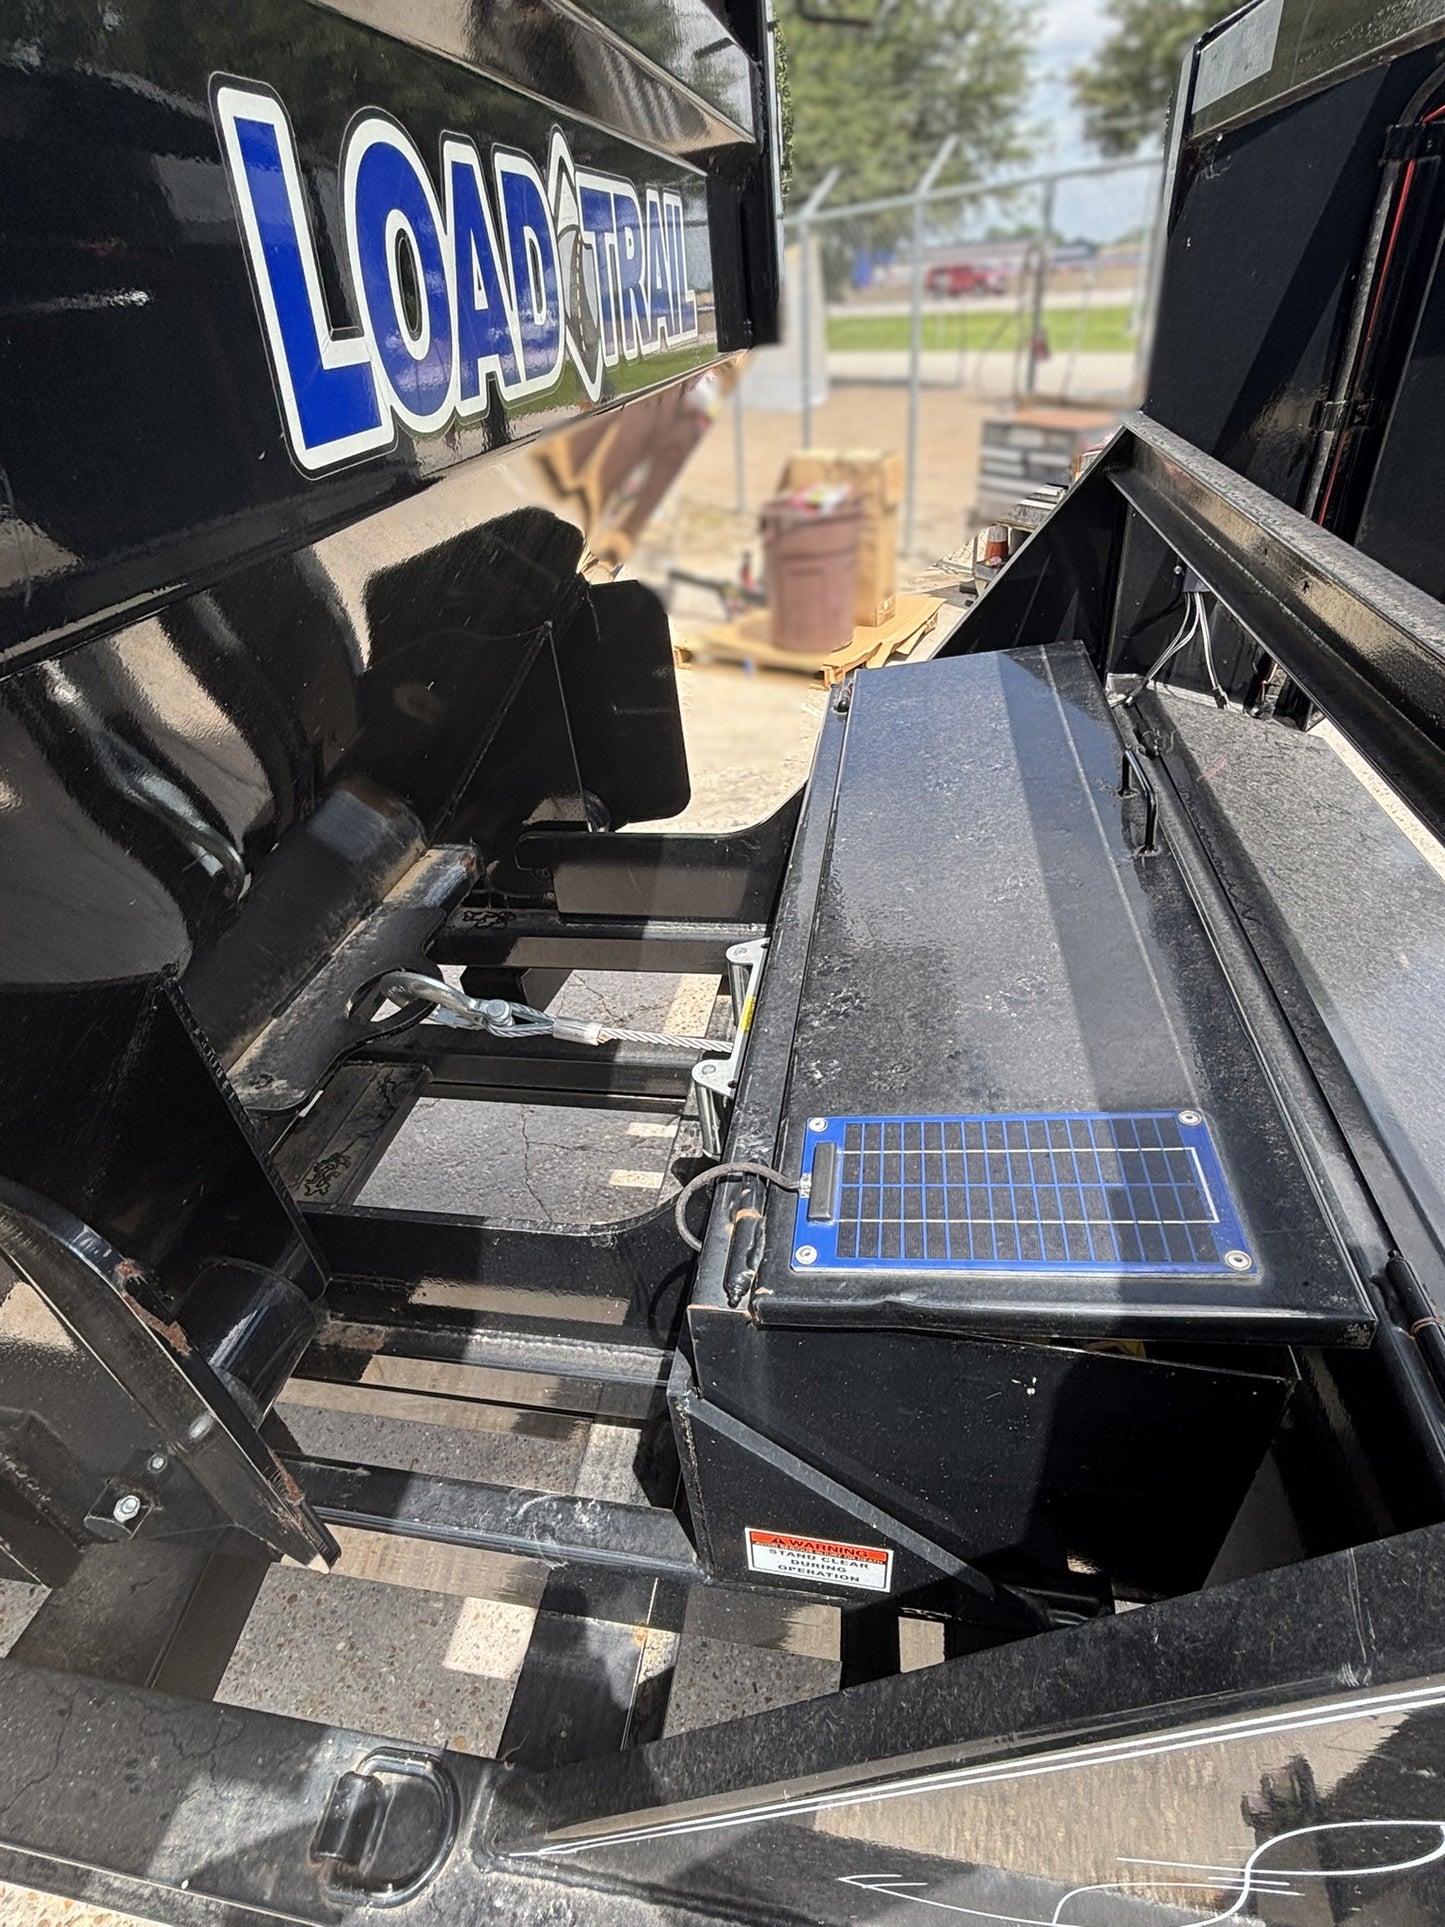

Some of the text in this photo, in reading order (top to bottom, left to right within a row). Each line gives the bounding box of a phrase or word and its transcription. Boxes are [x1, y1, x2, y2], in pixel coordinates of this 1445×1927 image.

[217, 87, 698, 470] LOAD TRAIL
[789, 1539, 868, 1558] WARNING
[768, 1548, 869, 1570] STAND CLEAR
[790, 1559, 847, 1573] DURING
[777, 1564, 860, 1583] OPERATION
